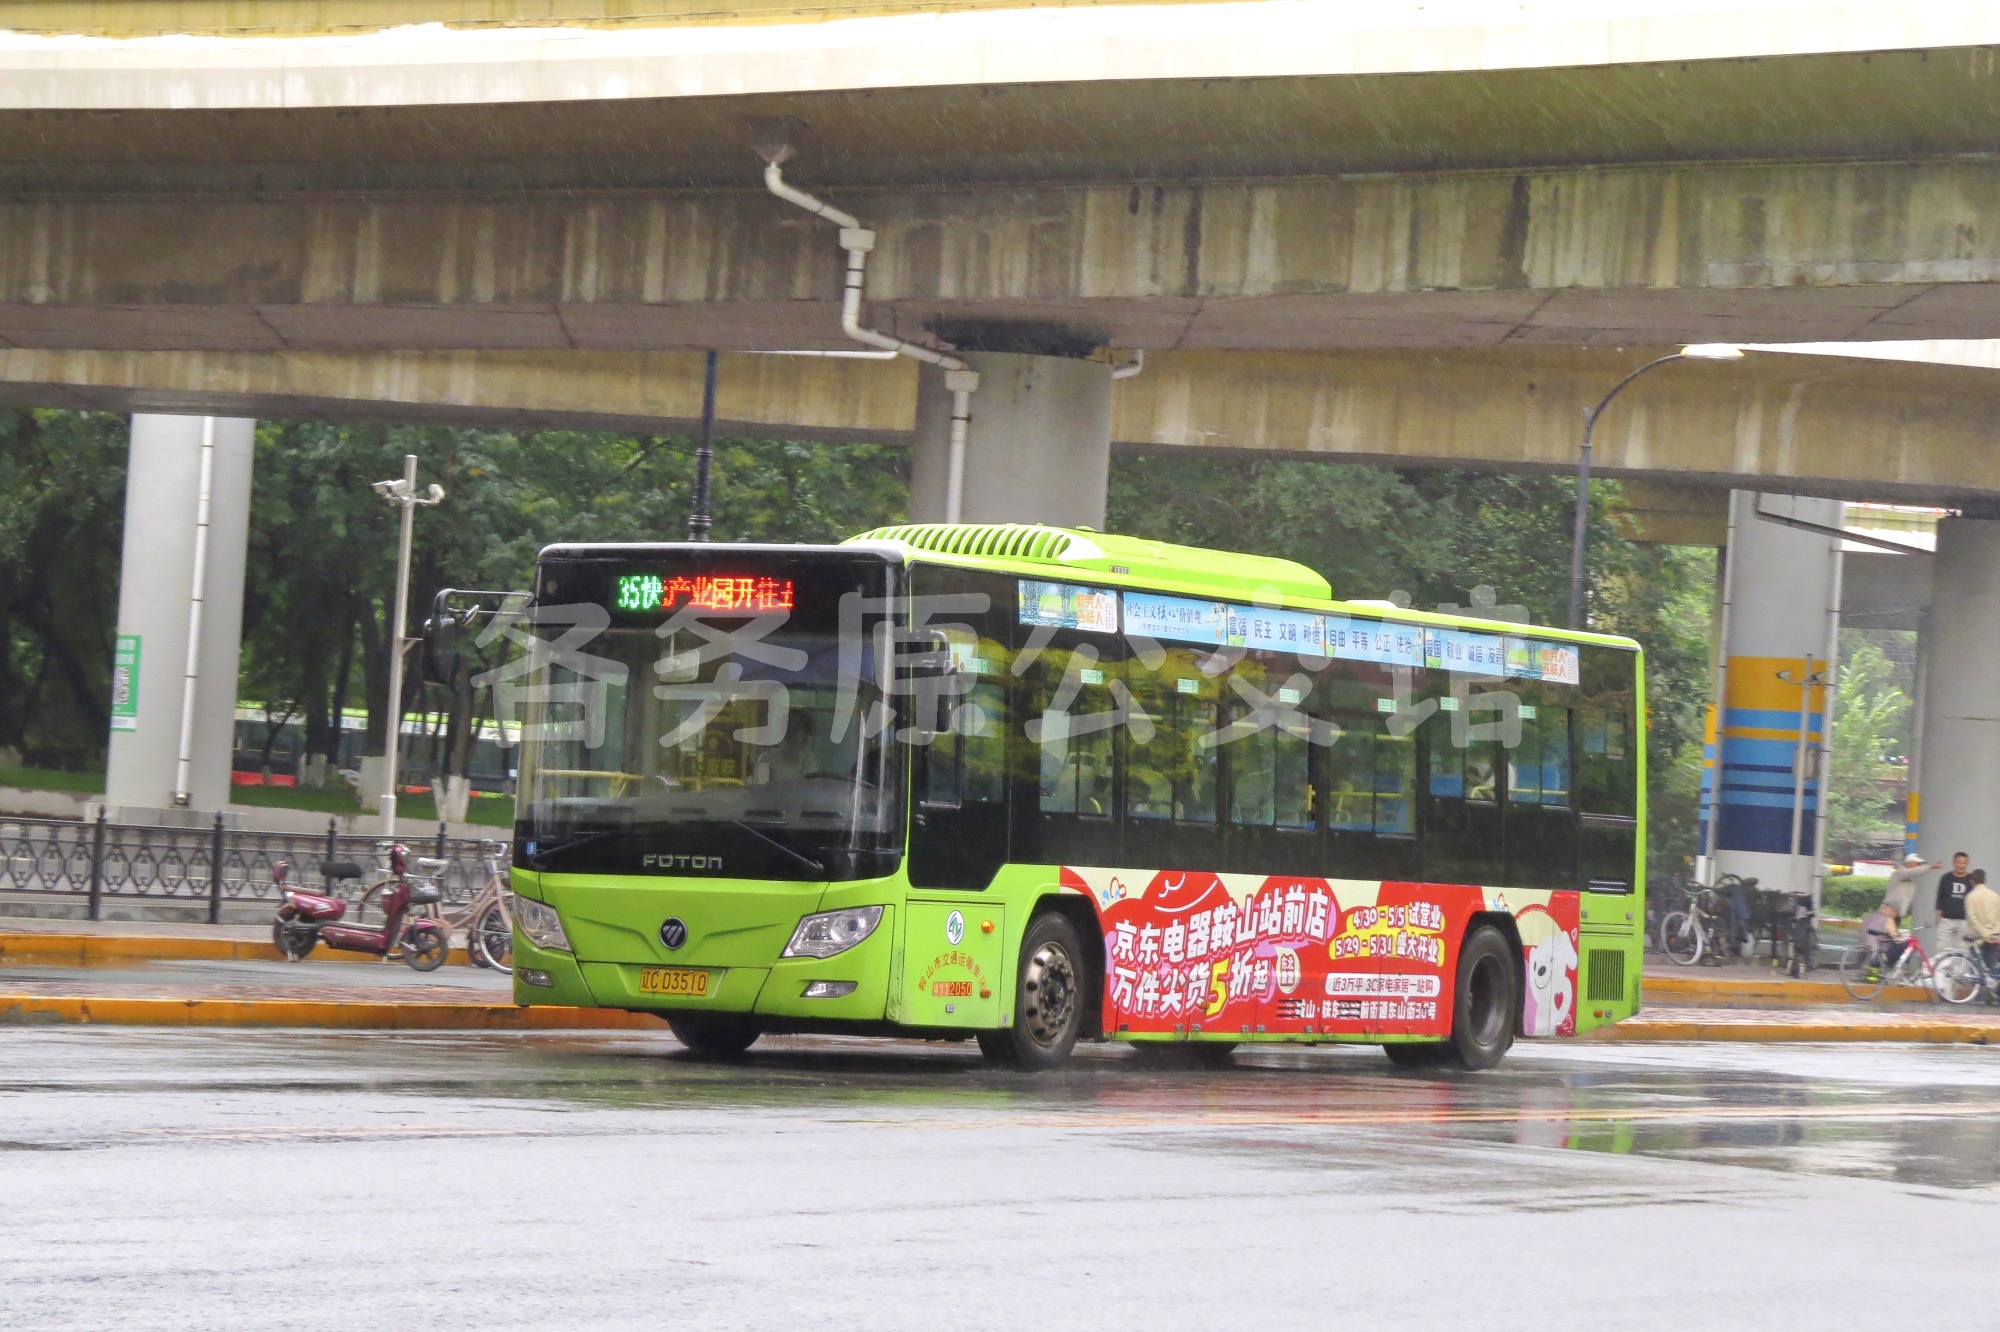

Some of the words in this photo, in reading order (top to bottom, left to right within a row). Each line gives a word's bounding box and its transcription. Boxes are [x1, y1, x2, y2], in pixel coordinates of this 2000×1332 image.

[618, 575, 663, 609] 35快
[1229, 616, 1247, 637] 富强
[1254, 619, 1272, 640] 民主
[1279, 622, 1297, 642] 文明
[1303, 624, 1320, 645] 和谐
[1329, 629, 1346, 648] 自由
[1352, 631, 1369, 651] 平等
[1374, 633, 1391, 653] 公正
[1396, 635, 1412, 655] 法治
[1426, 640, 1442, 658] 爱国
[1446, 641, 1463, 661] 敬业
[1467, 645, 1483, 663] 诚信
[1488, 646, 1503, 666] 友善
[643, 854, 723, 870] FOTON
[1953, 882, 1966, 894] D
[1112, 884, 1329, 965] 京东电器鞍山站前店
[1408, 901, 1442, 930] 试营业
[1397, 930, 1439, 963] 盛大开业
[1111, 947, 1271, 1017] 万件尖货5折起
[1332, 977, 1363, 992] 近3万平
[1366, 978, 1434, 994] 3C家电家居一站购
